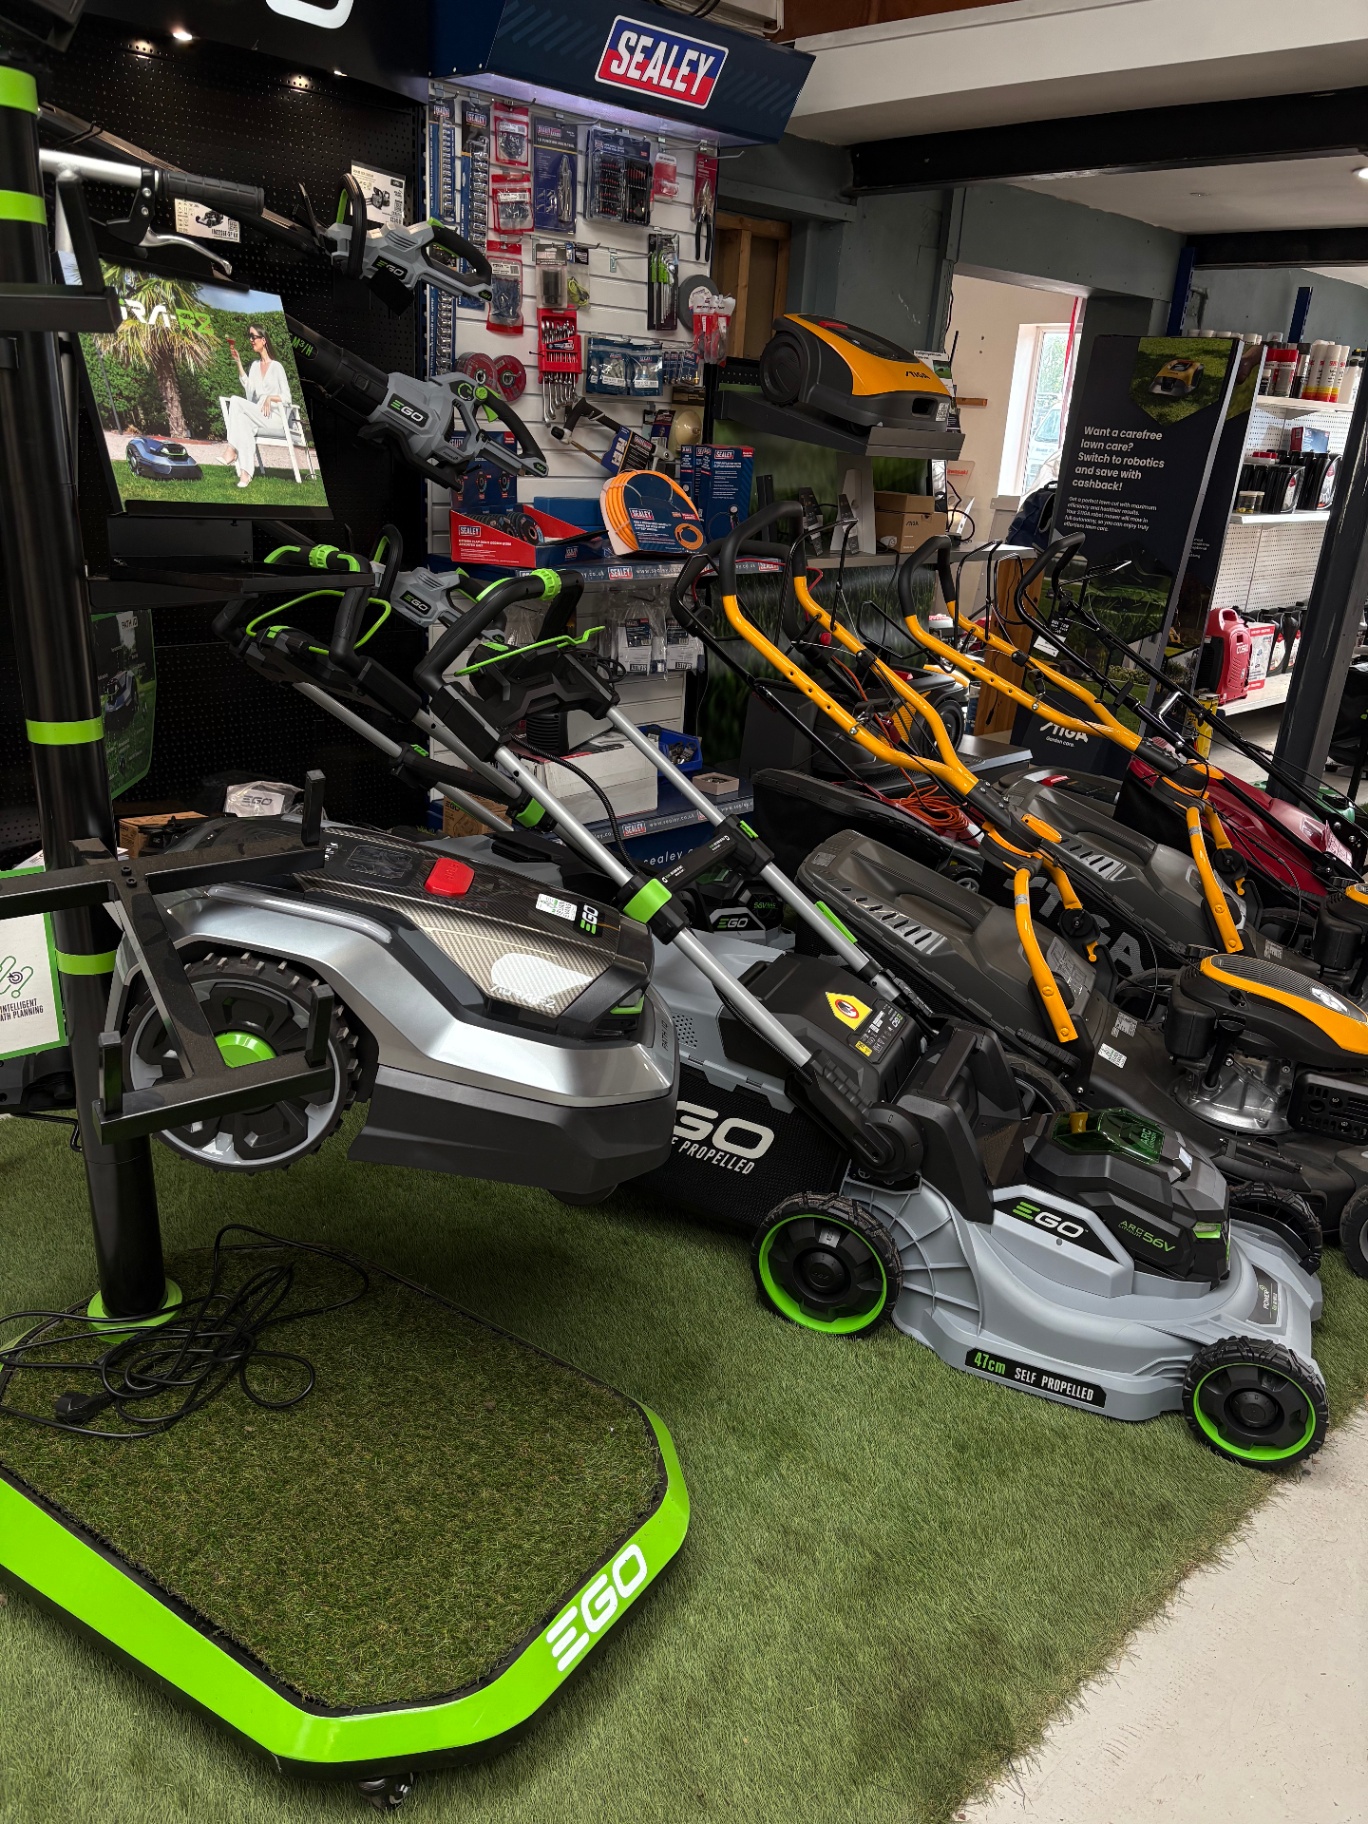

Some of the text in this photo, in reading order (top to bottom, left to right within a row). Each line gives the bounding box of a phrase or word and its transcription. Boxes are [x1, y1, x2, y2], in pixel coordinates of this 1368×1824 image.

[611, 30, 717, 96] SEALEY
[390, 399, 424, 422] EGO
[1084, 426, 1163, 441] Want a carefree
[1080, 439, 1134, 452] lawn care?
[1078, 452, 1165, 468] Switch to robotics
[1075, 466, 1142, 480] and save with
[1072, 479, 1123, 491] cashback!
[460, 526, 479, 536] SEALEY
[610, 567, 631, 577] SEALEY
[403, 595, 428, 611] EGO
[242, 795, 273, 806] EGO
[624, 824, 645, 835] SEALEY
[580, 904, 599, 935] EGO
[717, 918, 749, 929] EGO
[0, 998, 38, 1014] INTELLIGENT
[0, 1005, 44, 1022] ATH PLANNING
[661, 1030, 669, 1052] PATH
[673, 1100, 775, 1160] GO
[1140, 1128, 1152, 1145] ARC
[678, 1140, 755, 1175] PROPELLED
[1012, 1201, 1085, 1239] EGO
[1120, 1220, 1176, 1252] ARC 56V
[974, 1351, 1095, 1402] 47cm SELF PROPELLED
[546, 1544, 648, 1672] EGO
